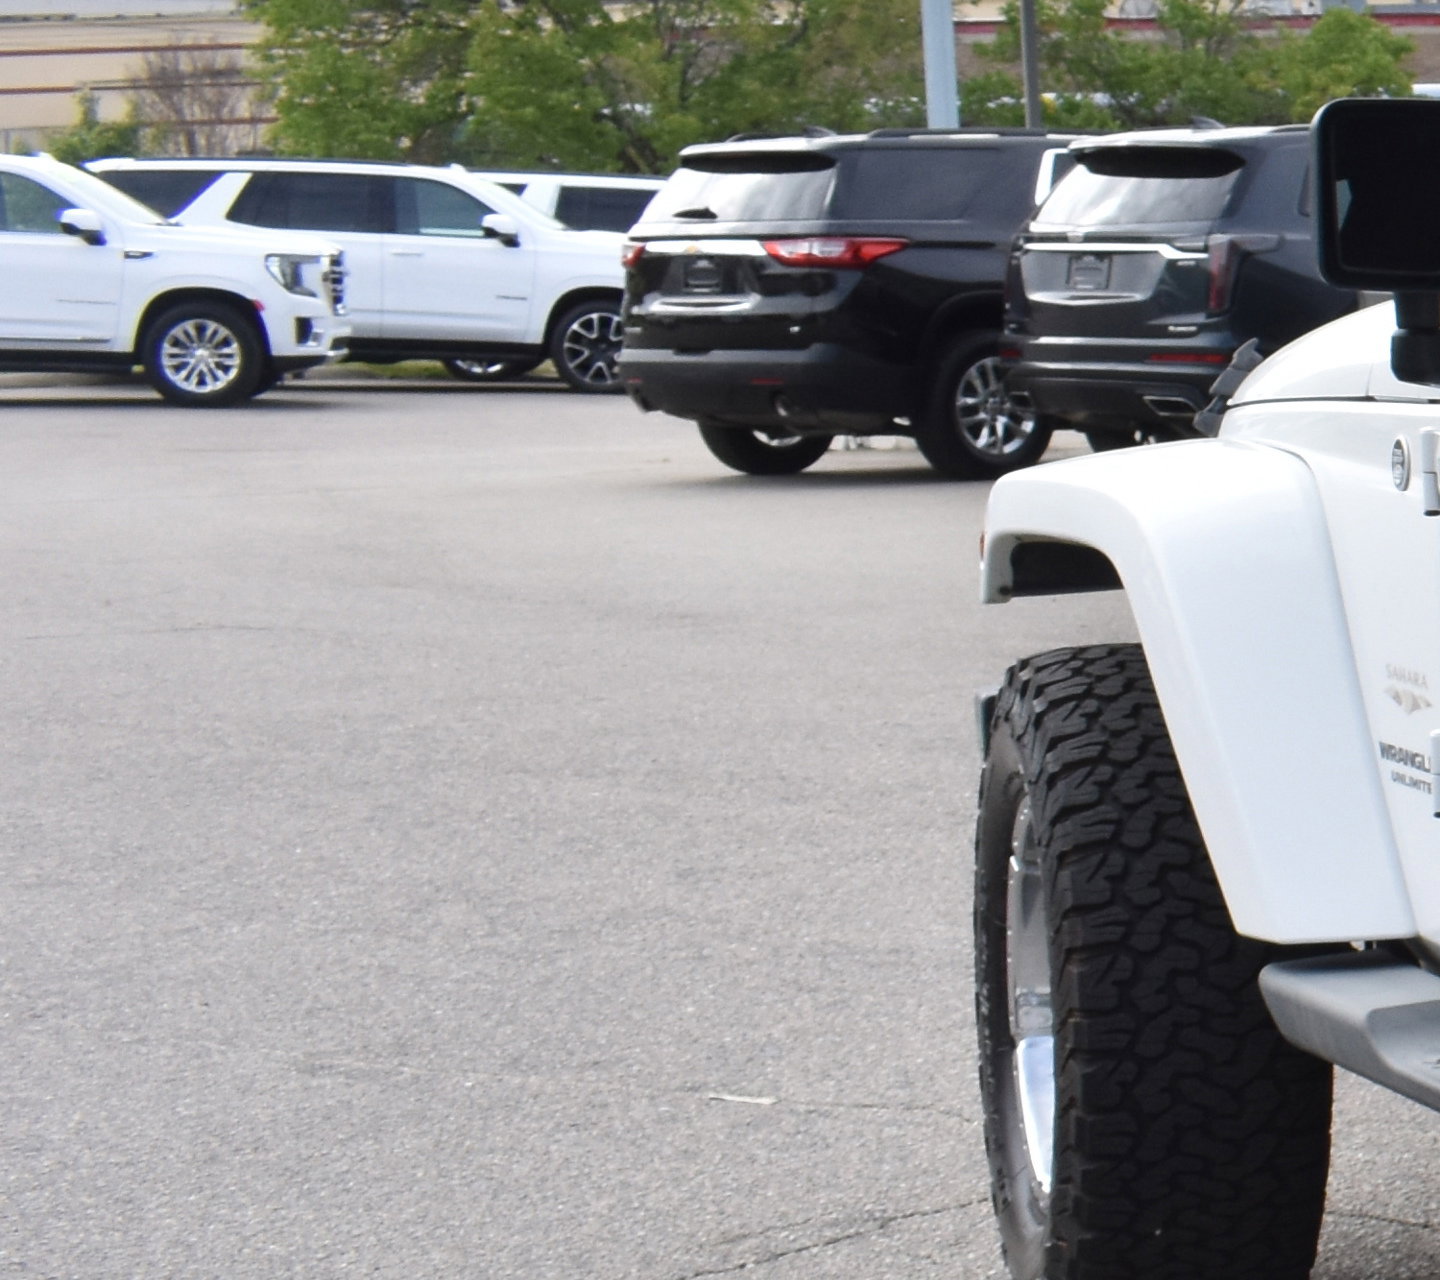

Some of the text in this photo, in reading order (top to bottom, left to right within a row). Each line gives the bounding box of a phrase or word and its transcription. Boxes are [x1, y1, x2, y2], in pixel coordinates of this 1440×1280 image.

[1385, 663, 1429, 689] SAHARA
[1378, 740, 1431, 773] WRANGL
[1390, 769, 1432, 795] UNLIMITE
